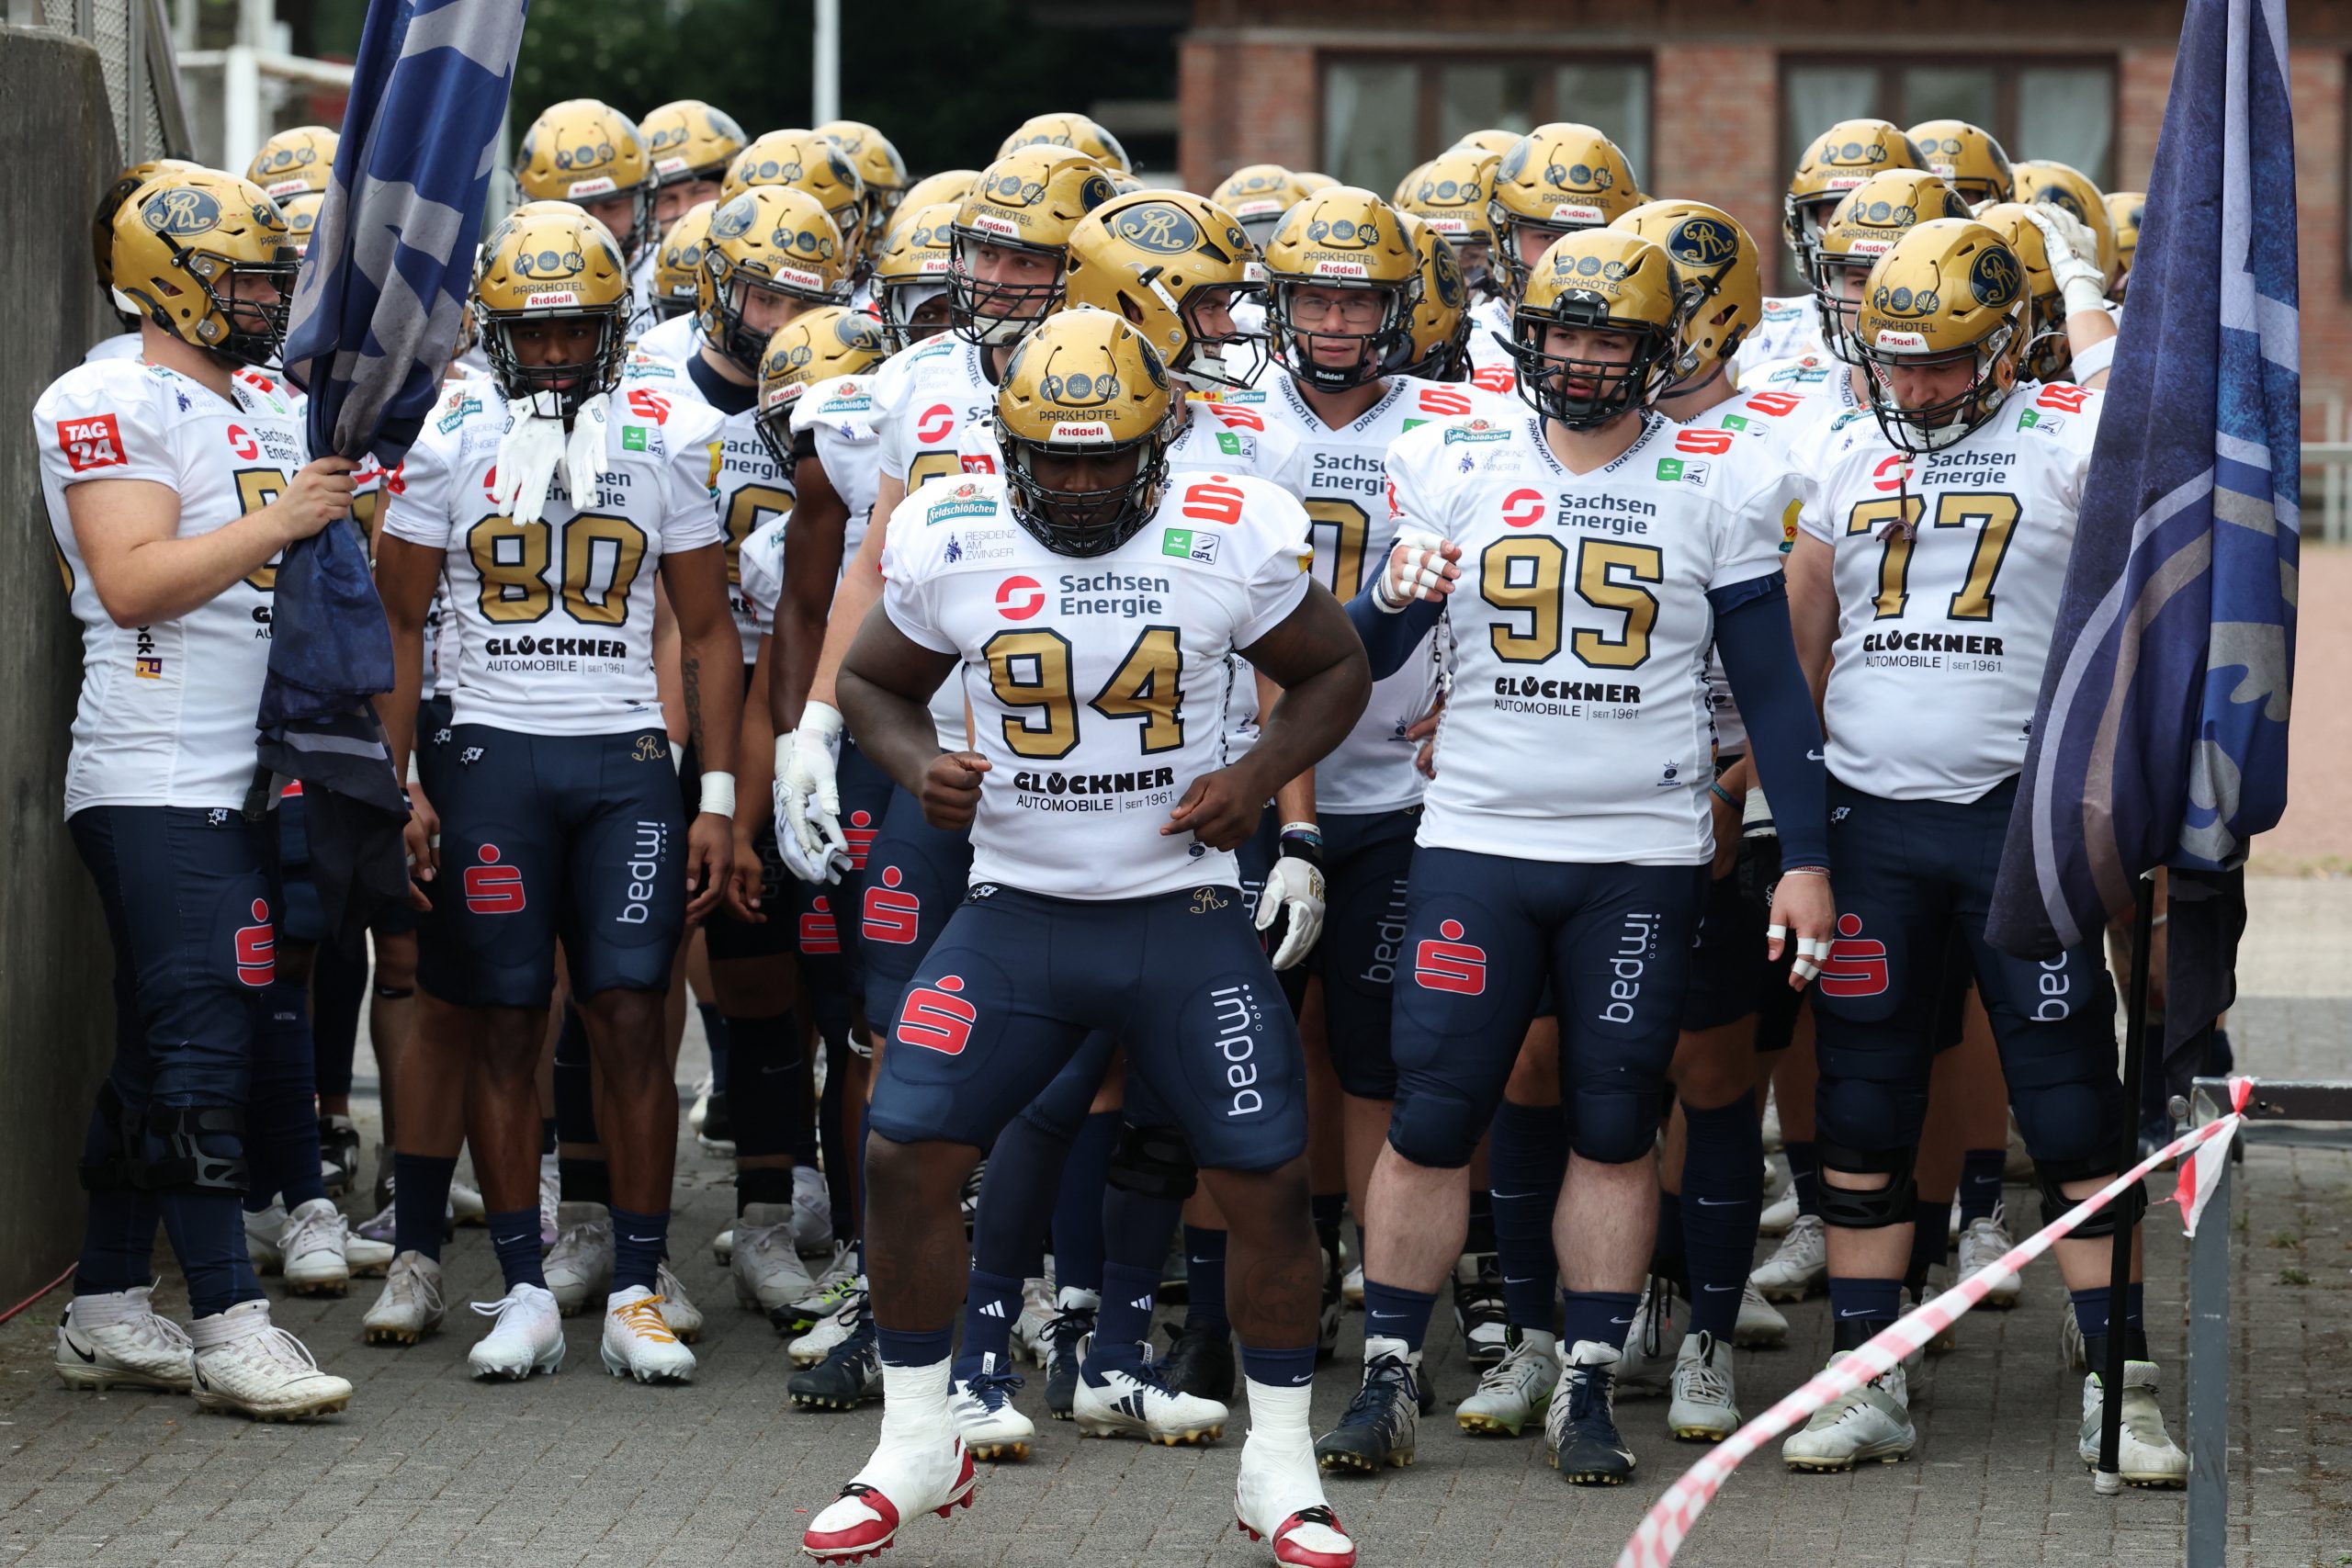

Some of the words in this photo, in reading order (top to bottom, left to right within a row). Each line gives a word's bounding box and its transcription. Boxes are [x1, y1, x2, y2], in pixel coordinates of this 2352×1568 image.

[1817, 168, 1881, 178] PARKHOTE
[1543, 194, 1612, 209] PARKHOTEL
[971, 203, 1034, 227] PARKHOTEL
[978, 219, 1012, 233] Riddell
[1433, 221, 1461, 231] ddell
[1843, 229, 1905, 239] PARKHOTE
[910, 251, 950, 264] PARKH
[1855, 243, 1889, 254] Ridde
[926, 262, 950, 272] Ridd
[1303, 252, 1377, 265] PARKHOTEL
[783, 270, 820, 287] Riddell
[1320, 264, 1363, 276] Riddell
[514, 281, 586, 296] PARKHOTEL
[1550, 277, 1623, 297] PARKHOTEL
[531, 294, 572, 306] Riddell
[1316, 371, 1344, 382] Riddell
[771, 385, 803, 404] Riddell
[1278, 375, 1319, 434] PARKHOTEL
[1353, 389, 1403, 433] DRESDEN
[1039, 409, 1121, 422] PARKHOTEL
[65, 422, 108, 441] TAG
[255, 427, 297, 446] Sachsen
[1058, 426, 1103, 437] Riddell
[1173, 428, 1193, 452] DRES
[70, 438, 119, 467] 24
[1526, 417, 1562, 476] PARKHOTEL
[1603, 426, 1657, 474] DRESDEN
[1314, 453, 1386, 472] Sachs
[1927, 449, 2016, 468] Sachsen
[1311, 473, 1386, 497] Energi
[1921, 468, 2007, 487] Energie
[1560, 493, 1657, 516] Sachsen
[1556, 511, 1648, 535] Energie
[965, 529, 1017, 541] RESIDENZ
[966, 540, 983, 551] AM
[966, 548, 1015, 560] ZWINGER
[1191, 550, 1213, 562] GFL
[1846, 491, 2023, 622] 77
[466, 512, 649, 626] 80
[1059, 571, 1170, 593] Sachsen
[1060, 594, 1163, 618] Energie
[1480, 534, 1664, 671] 95
[485, 660, 577, 672] AUTOMOBILE
[587, 665, 603, 673] SEIT
[1865, 655, 1942, 669] AUTOMOBILE
[1952, 661, 1970, 671] SEIT
[980, 625, 1185, 760] 94
[1494, 698, 1581, 718] AUTOMOBILE
[1592, 710, 1610, 719] SEIT
[1016, 794, 1114, 812] AUTOMOBILE
[1125, 799, 1144, 809] SEIT
[616, 820, 668, 924] impaq
[1599, 913, 1661, 1023] impaq
[2029, 951, 2071, 1023] paq
[1210, 984, 1265, 1117] impaq
